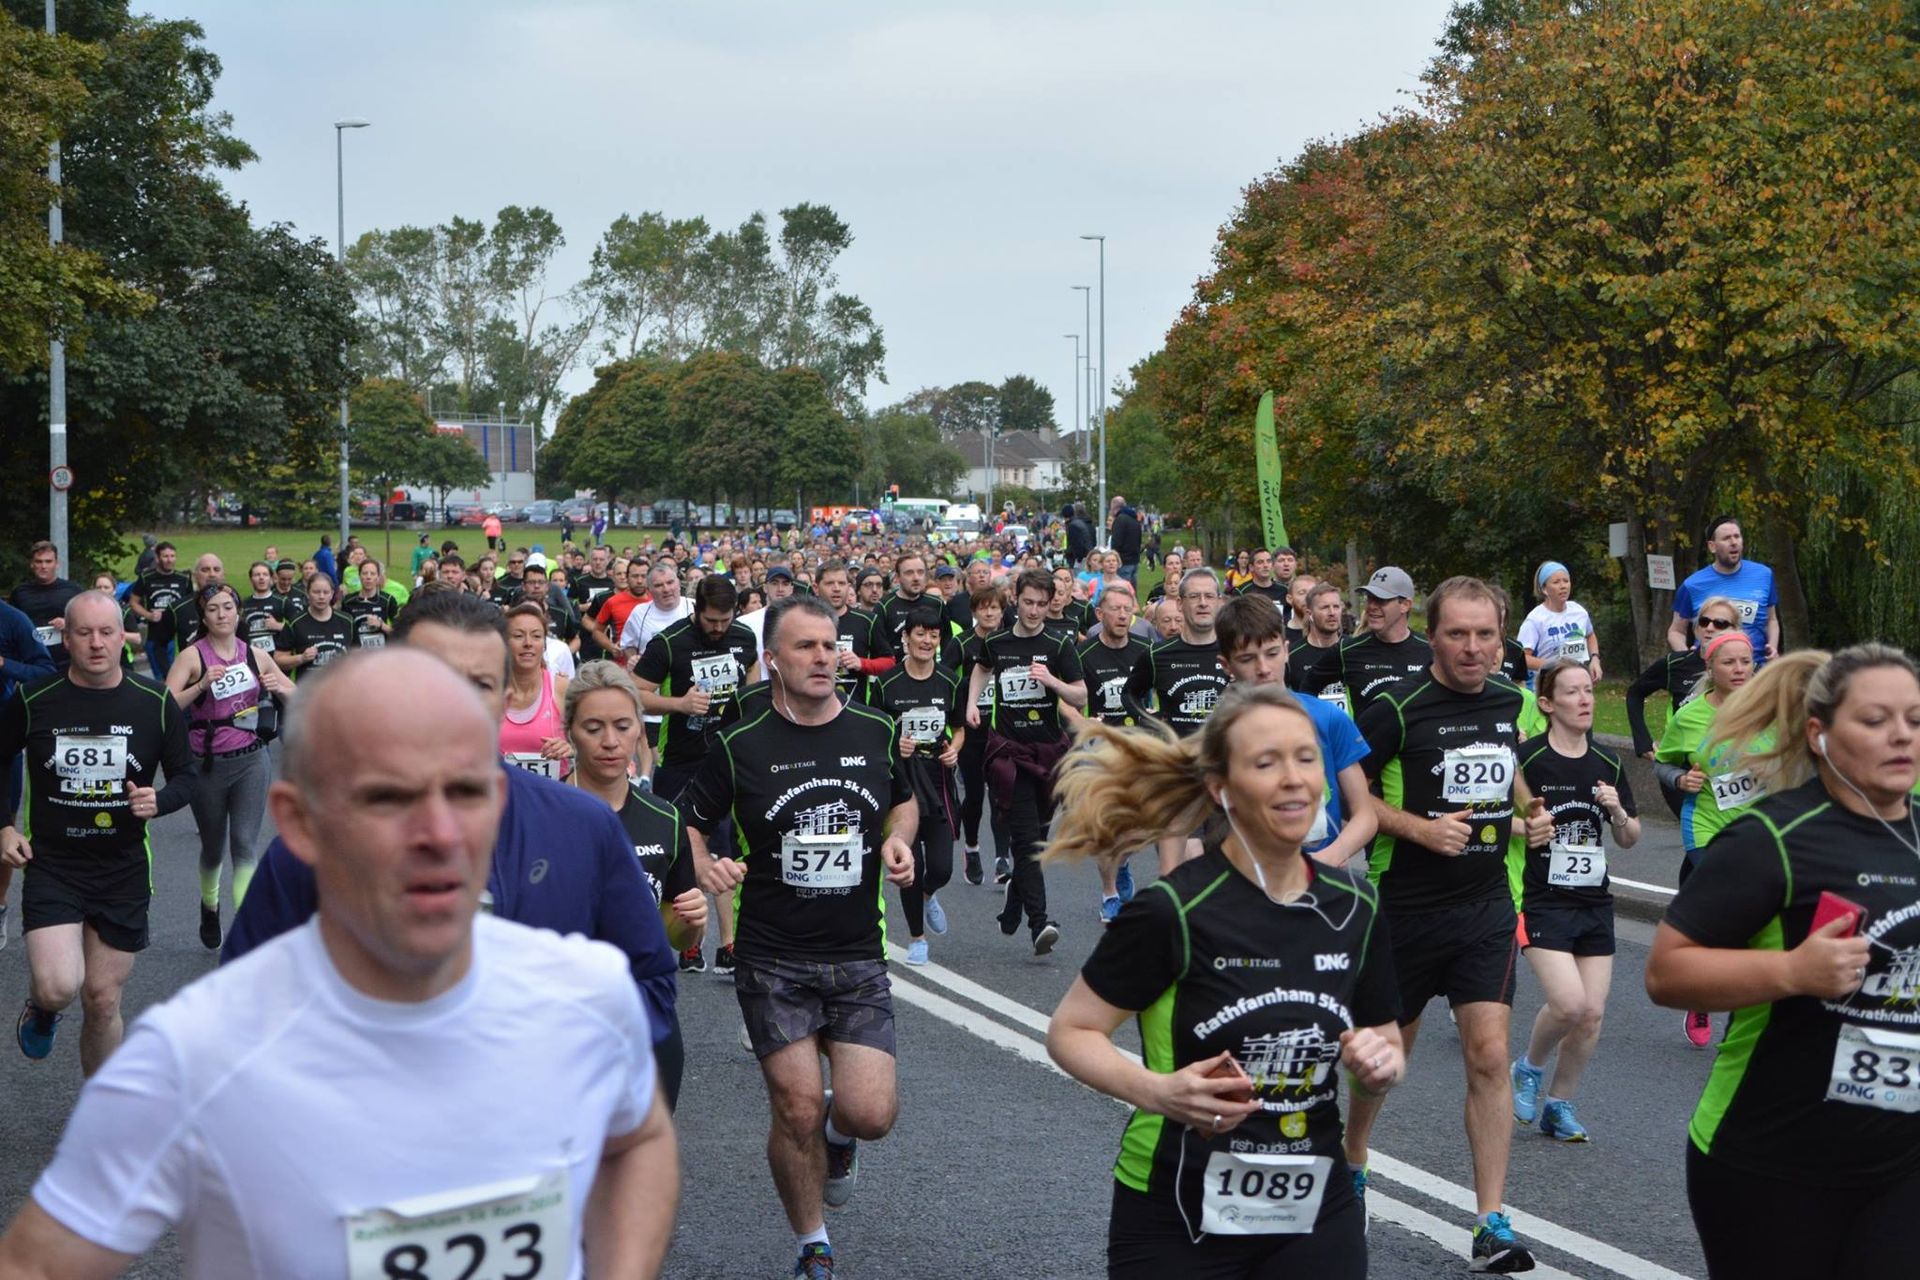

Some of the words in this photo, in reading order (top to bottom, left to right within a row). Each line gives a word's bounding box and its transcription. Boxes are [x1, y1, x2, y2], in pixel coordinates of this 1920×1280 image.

[699, 662, 732, 680] 164
[214, 670, 248, 692] 592
[1007, 678, 1038, 693] 173
[110, 724, 134, 735] DNG
[908, 720, 940, 732] 156
[64, 748, 116, 767] 681
[779, 760, 817, 771] HERITAGE
[840, 756, 866, 767] DNG
[60, 766, 80, 775] DNG
[1454, 762, 1505, 784] 820
[1448, 785, 1470, 795] DNG
[1716, 776, 1758, 799] 100
[764, 778, 842, 822] Rathfarnham
[844, 780, 860, 794] 5k
[860, 788, 880, 812] Run
[636, 844, 664, 857] DNG
[792, 849, 852, 872] 574
[1566, 856, 1592, 875] 23
[644, 872, 656, 886] k
[786, 871, 810, 882] DNG
[1552, 873, 1570, 882] DNG
[1870, 874, 1918, 886] HERITAGE
[1228, 958, 1282, 969] HERITAGE
[1313, 952, 1350, 972] DNG
[1192, 986, 1316, 1041] Rathfarnham
[1317, 992, 1340, 1016] 5k
[1849, 1050, 1920, 1089] 83
[1836, 1082, 1876, 1100] DNG
[1216, 1168, 1315, 1201] 1089
[382, 1222, 544, 1280] 823
